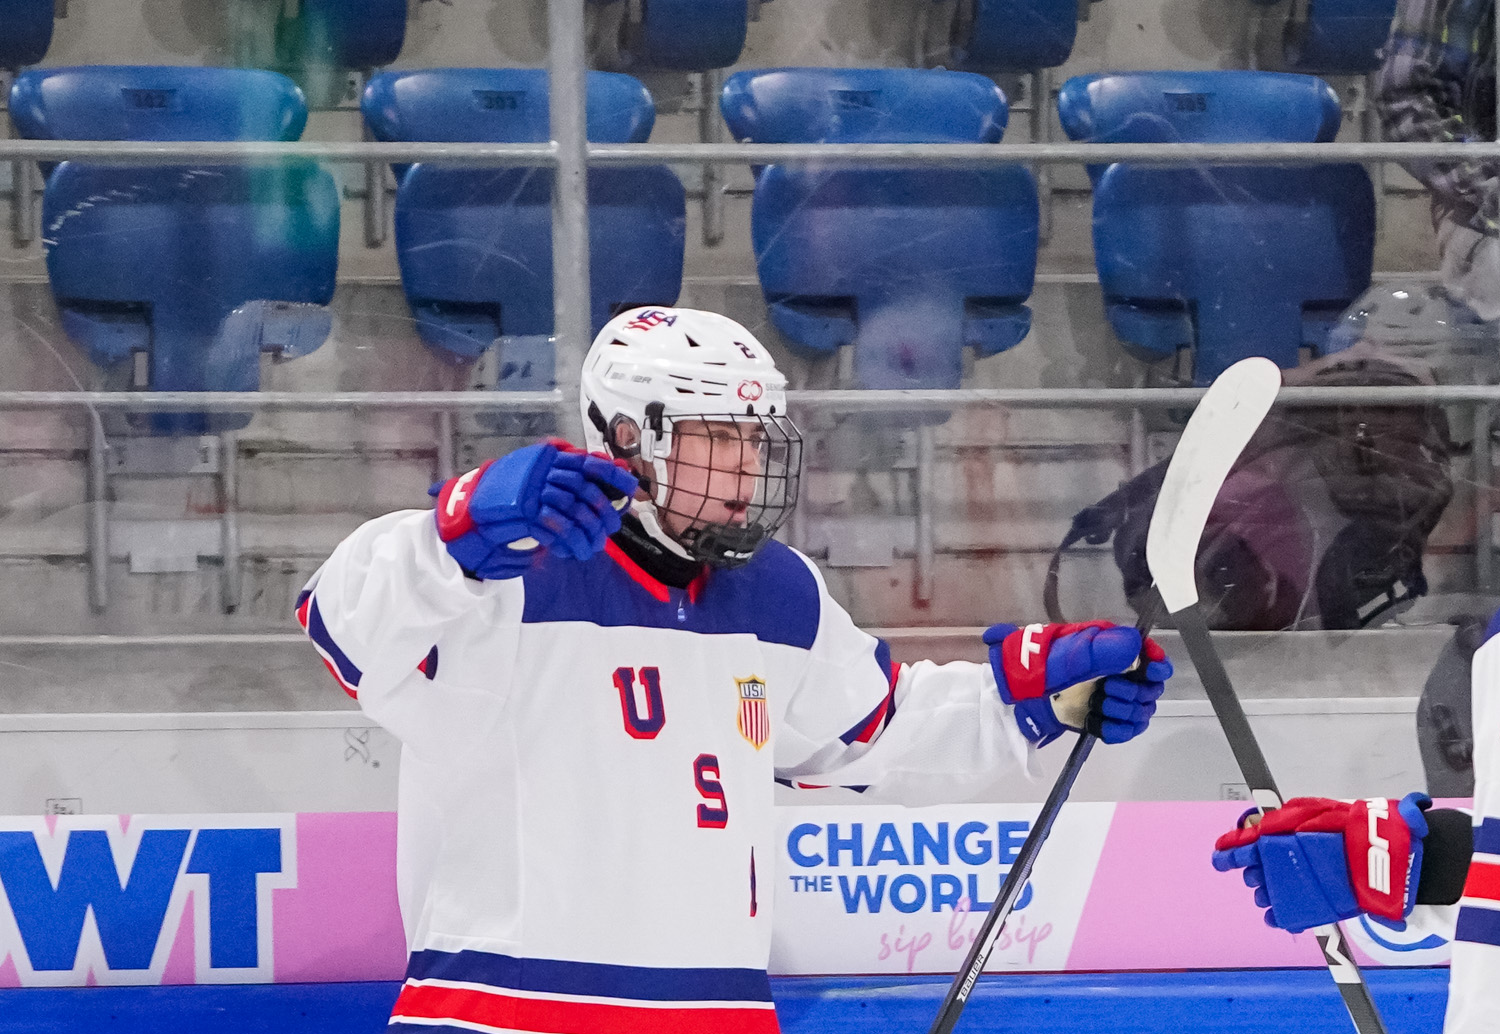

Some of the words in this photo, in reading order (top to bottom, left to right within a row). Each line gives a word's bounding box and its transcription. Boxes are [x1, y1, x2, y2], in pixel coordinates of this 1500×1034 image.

[733, 341, 757, 359] 2
[612, 666, 666, 740] U
[693, 753, 729, 829] S
[787, 820, 1030, 868] CHANGE
[789, 875, 832, 892] THE
[877, 924, 933, 973] sip
[960, 953, 985, 999] BAUER
